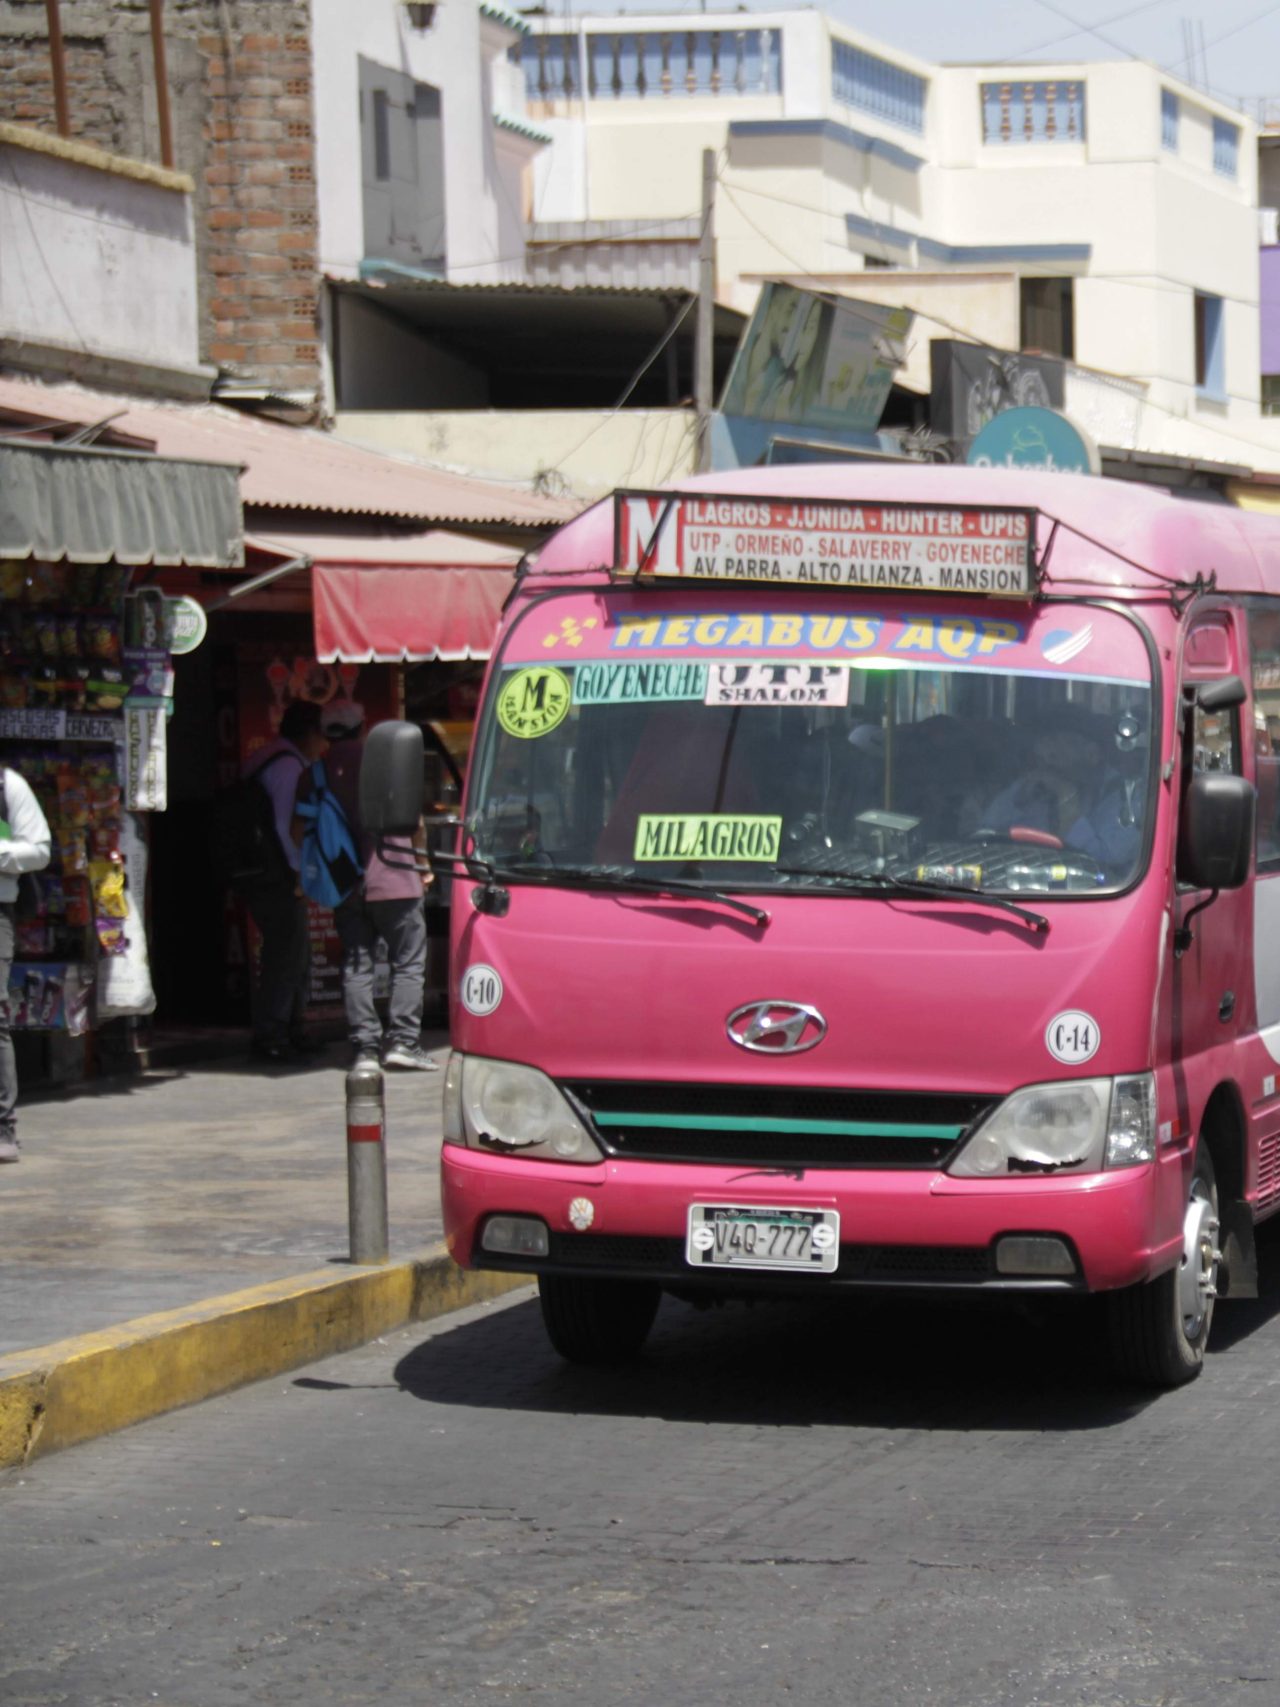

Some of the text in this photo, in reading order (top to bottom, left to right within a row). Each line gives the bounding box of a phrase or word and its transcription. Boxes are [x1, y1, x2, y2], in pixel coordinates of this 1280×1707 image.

[787, 503, 865, 531] J.UNIDA
[881, 509, 965, 535] HUNTER
[979, 513, 1027, 537] UPIS
[690, 531, 1026, 566] UTP ORMEÑO SALAVERRY GOYENECHE
[725, 558, 782, 580] PARRA
[798, 560, 842, 582] ALTO
[847, 563, 924, 587] ALIANZA
[939, 567, 1023, 590] MANSION
[613, 613, 1019, 661] MEGABUS AQP
[576, 663, 706, 700] GOYENECHE
[718, 665, 842, 686] UTP
[505, 693, 563, 729] MANSION
[520, 674, 550, 713] M
[719, 688, 829, 702] SHALOM
[641, 817, 779, 859] MILAGROS
[466, 975, 496, 1006] C-10
[1055, 1023, 1090, 1053] C-14
[715, 1221, 812, 1257] V4Q-777
